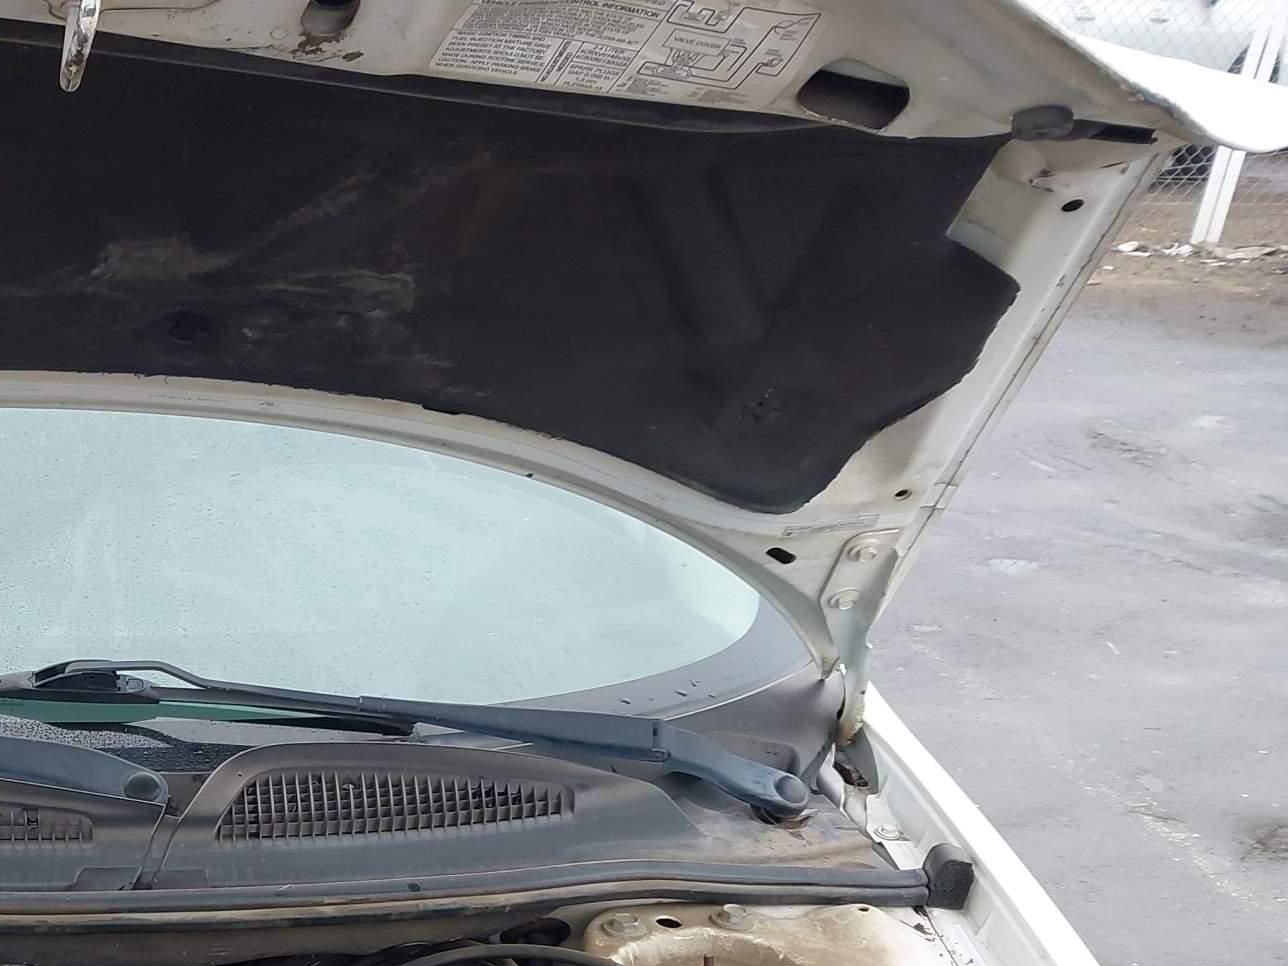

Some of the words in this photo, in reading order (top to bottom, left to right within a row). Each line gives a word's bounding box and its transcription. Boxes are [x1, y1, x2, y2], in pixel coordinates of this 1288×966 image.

[602, 2, 661, 18] INFORMATION
[673, 35, 694, 47] VALVE
[695, 40, 722, 50] COVER
[516, 46, 546, 55] FACTORY
[487, 55, 515, 63] ROUTINE
